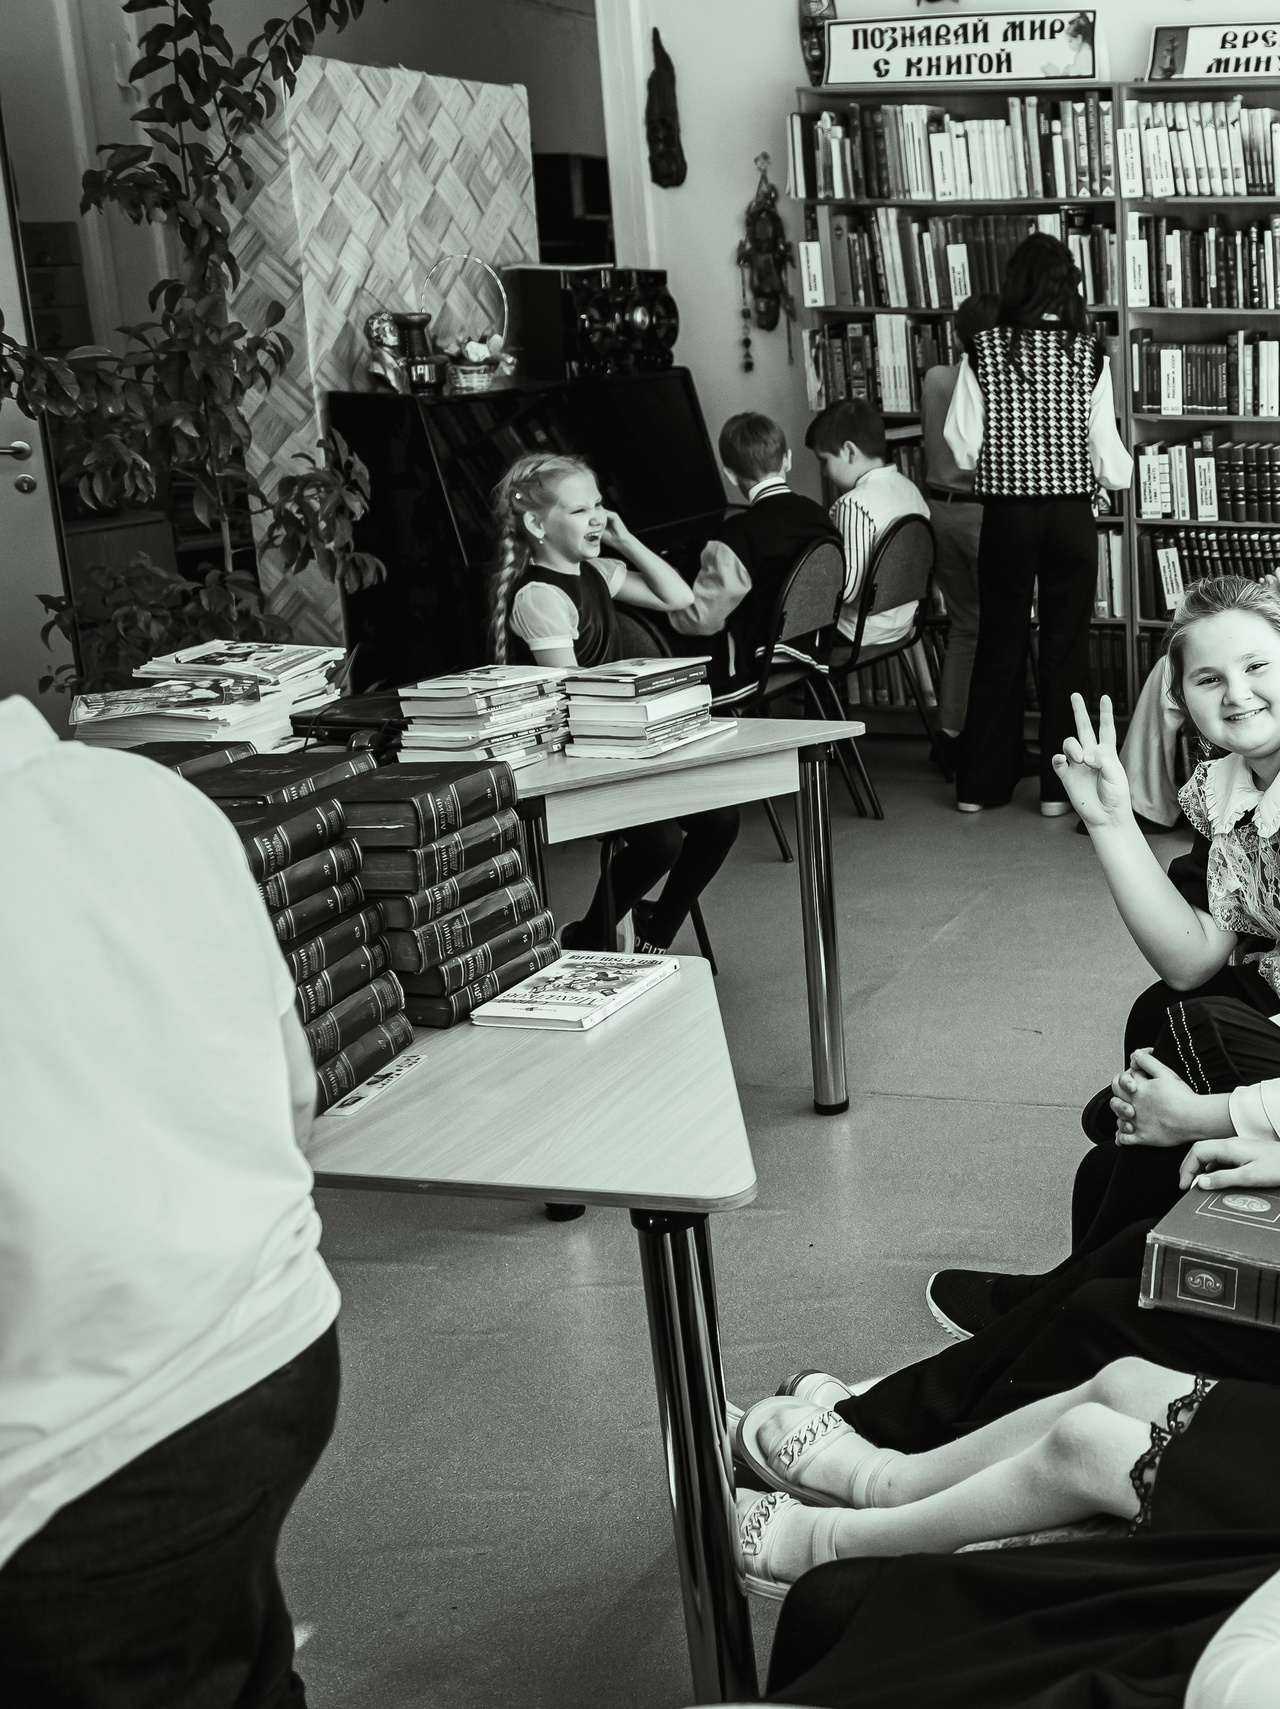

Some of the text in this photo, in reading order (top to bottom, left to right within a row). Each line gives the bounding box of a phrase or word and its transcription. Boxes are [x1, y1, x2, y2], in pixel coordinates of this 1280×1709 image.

[852, 17, 1065, 51] ПОЗНАВАЙ МИР
[873, 48, 1013, 78] С КНИГОЙ
[436, 798, 447, 830] ЛЕНИН
[262, 837, 276, 873] ЛЕНИН
[440, 844, 449, 877] ЛЕНИН
[432, 887, 442, 915] ЛЕНИН
[442, 923, 454, 955] ЛЕНИН
[299, 948, 309, 979] ЛЕНИН
[465, 953, 474, 980] ЛЕНИН
[305, 984, 316, 1014] ЛЕНИН
[325, 1067, 339, 1096] ЛЕНИН
